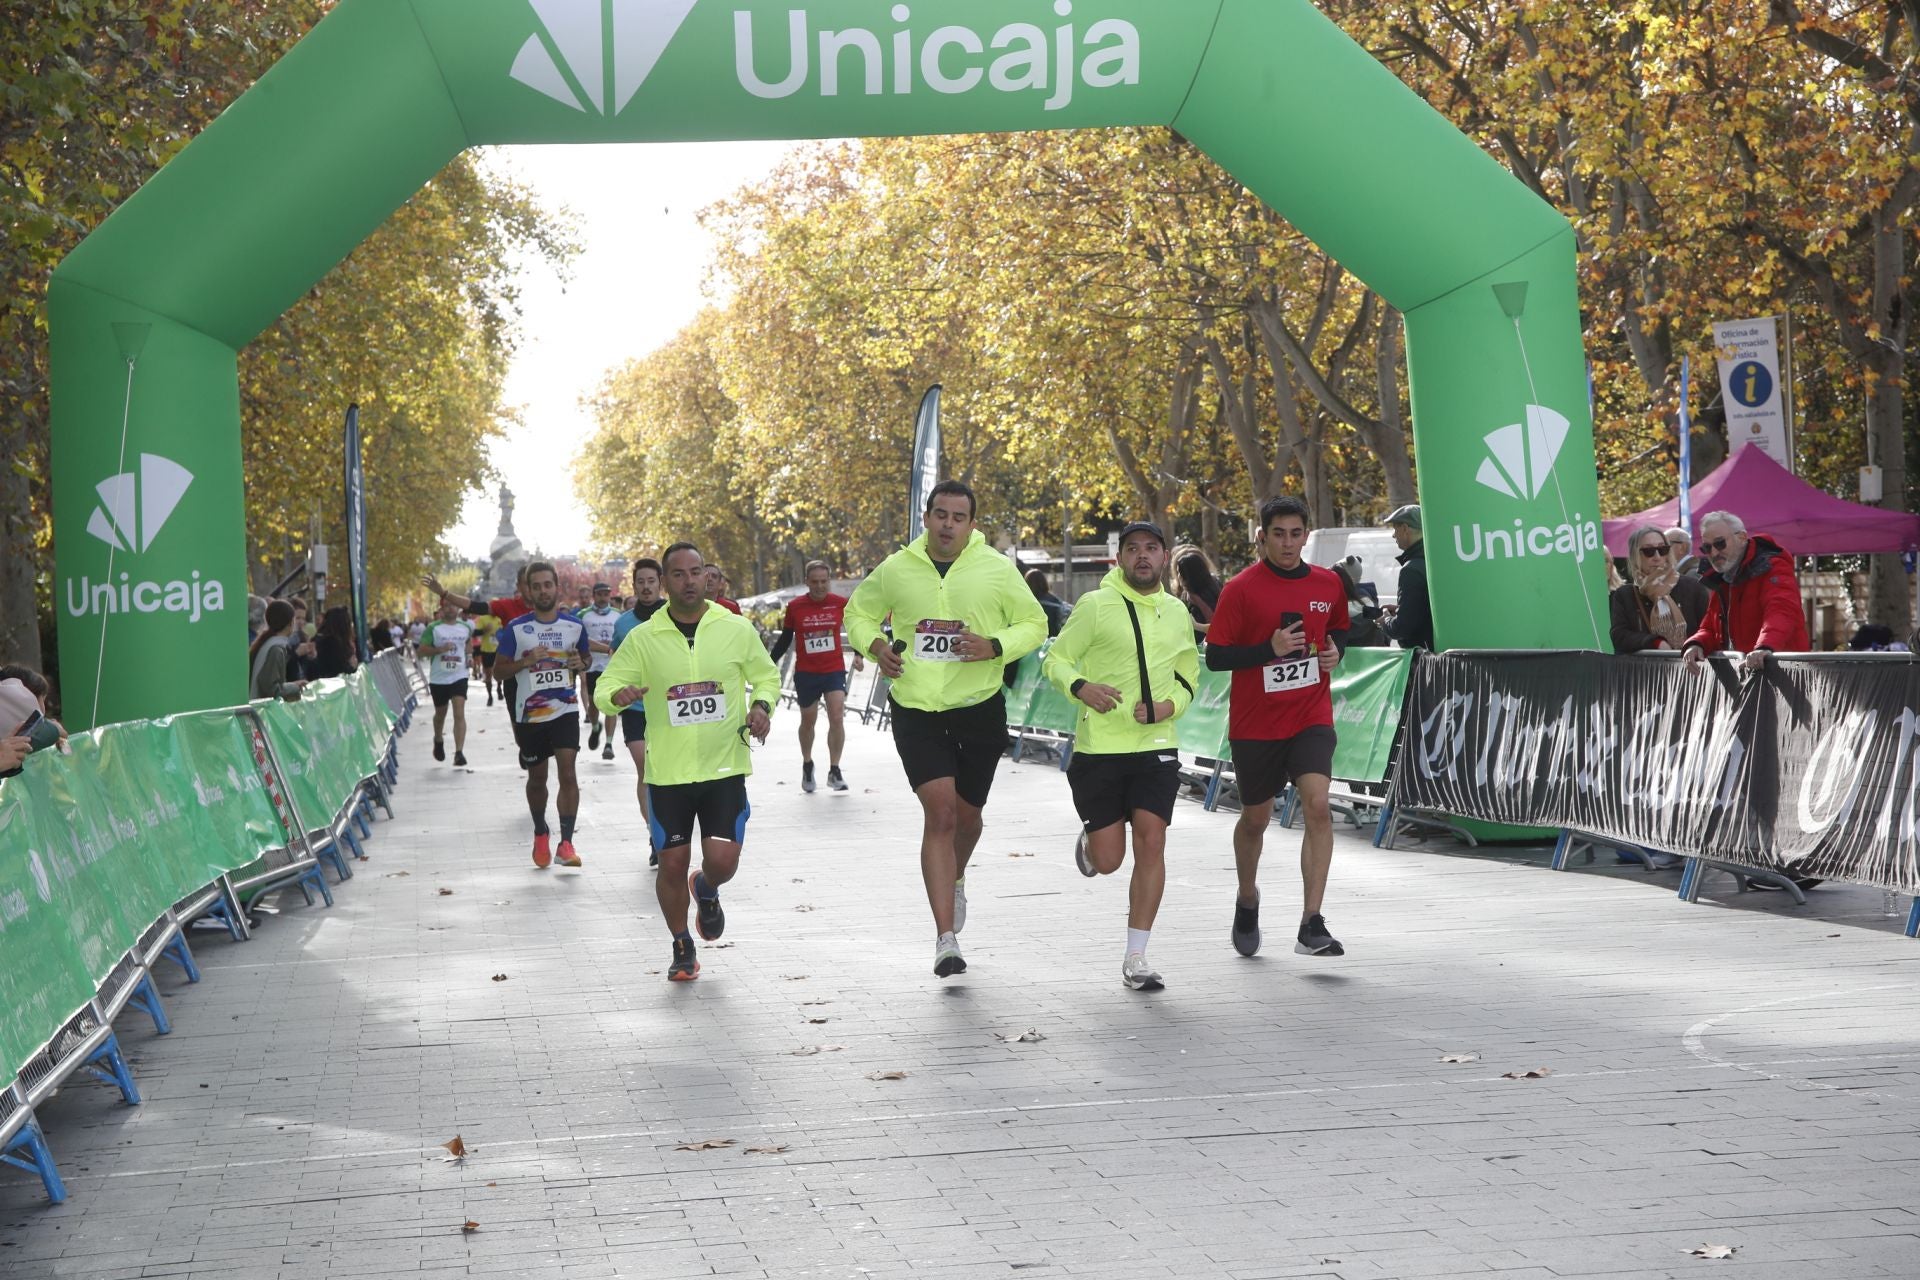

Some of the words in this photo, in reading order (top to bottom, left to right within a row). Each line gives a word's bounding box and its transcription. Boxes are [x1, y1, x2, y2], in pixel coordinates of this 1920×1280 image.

[733, 0, 1140, 111] Unicaja
[1453, 512, 1598, 564] Unicaja
[67, 570, 225, 623] Unicaja
[809, 638, 829, 649] 141
[535, 670, 563, 685] 205
[1272, 660, 1310, 683] 327
[676, 697, 717, 717] 209
